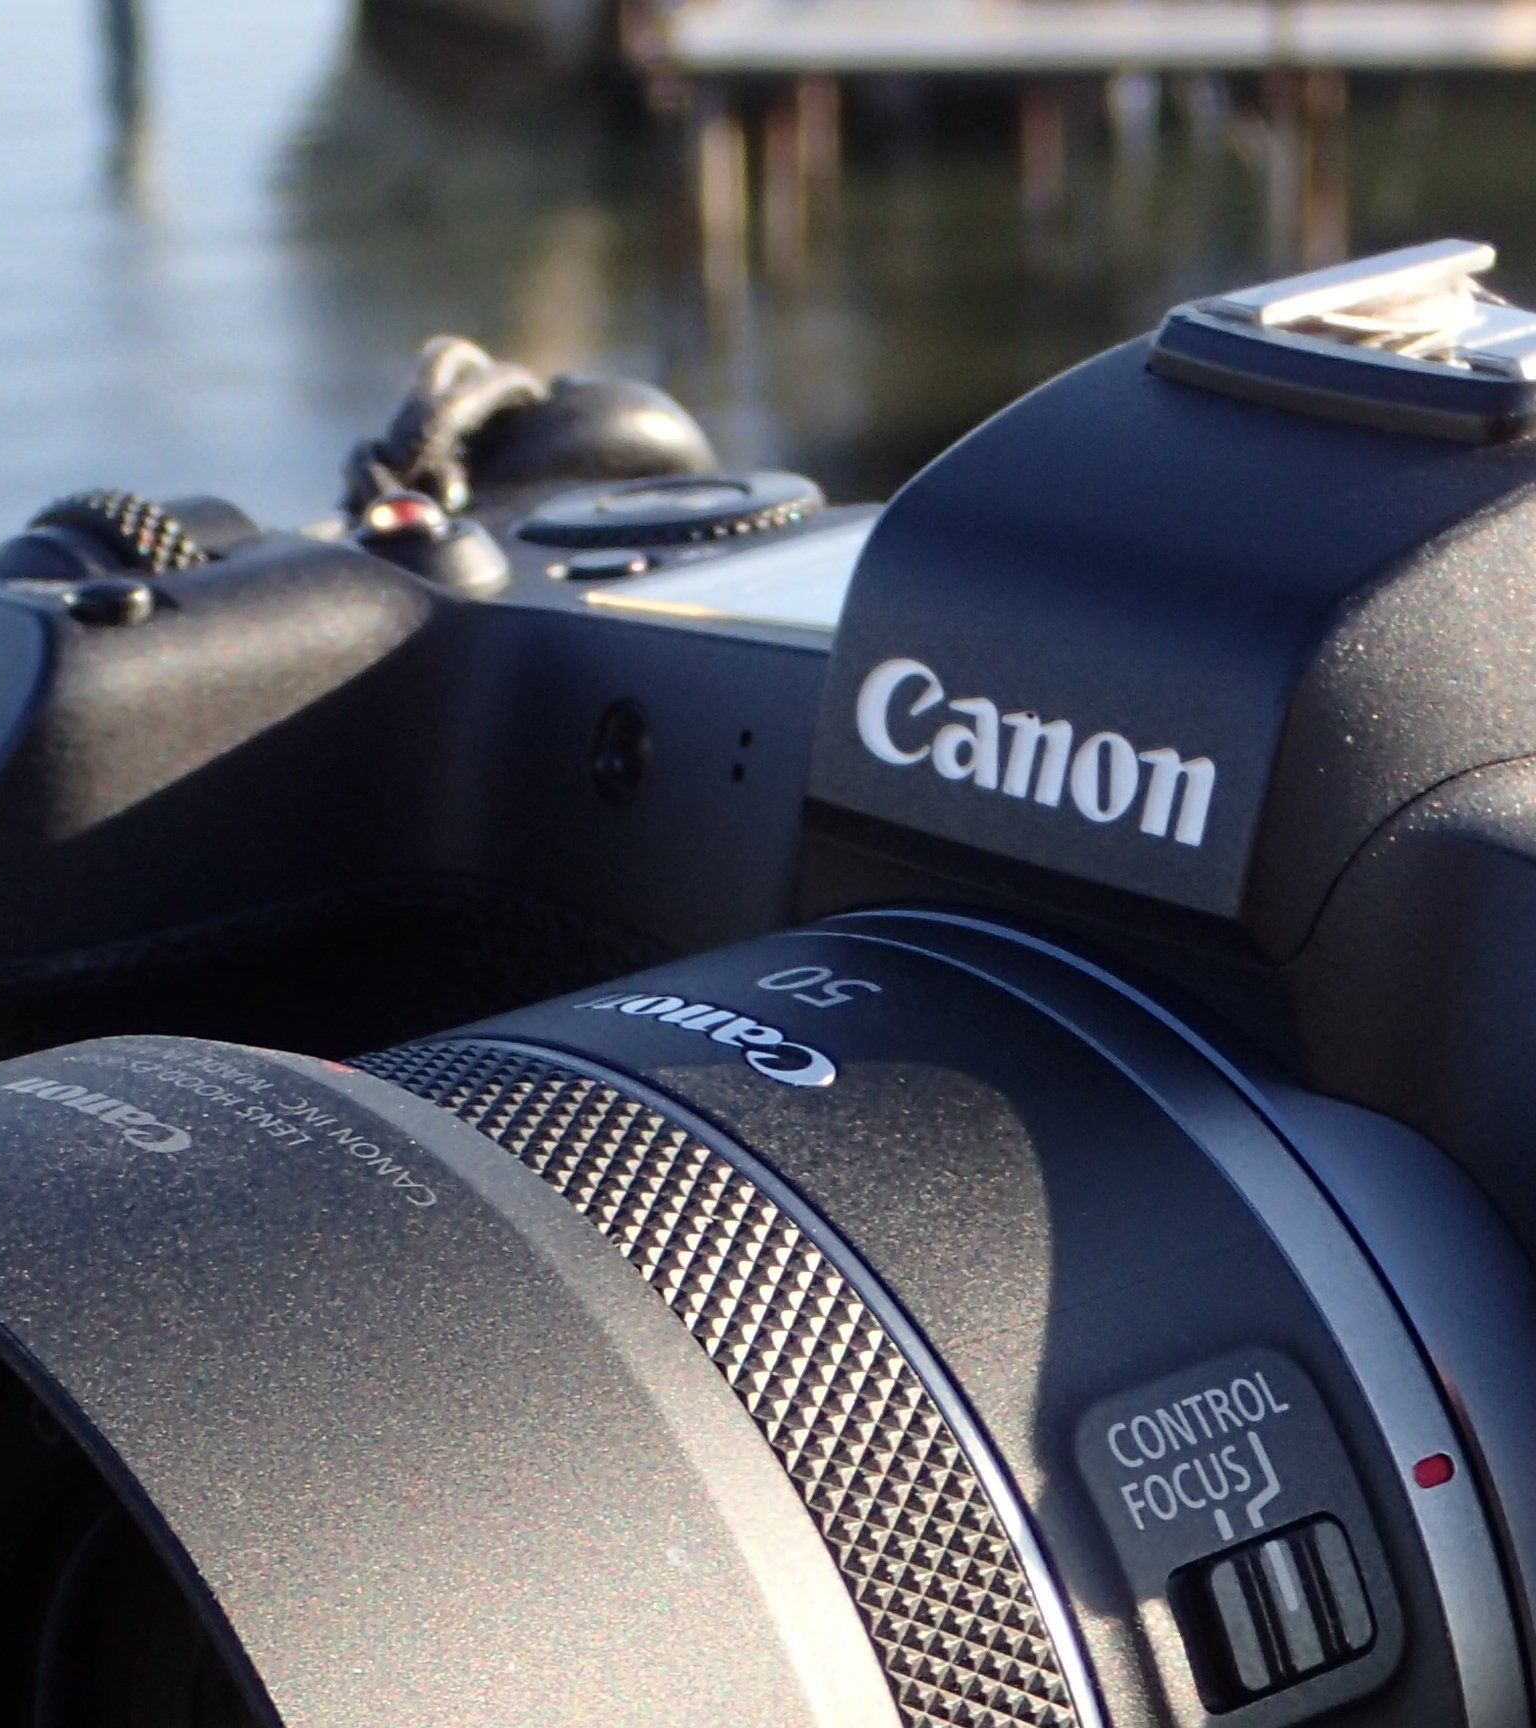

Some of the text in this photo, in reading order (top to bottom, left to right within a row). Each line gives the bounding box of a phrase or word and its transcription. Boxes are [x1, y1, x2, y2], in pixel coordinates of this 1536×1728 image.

[856, 658, 1216, 847] Canon
[757, 966, 883, 1008] 50
[572, 992, 838, 1088] Canon
[1, 1077, 193, 1154] Canon
[157, 1068, 315, 1146] LENS HOOD
[327, 1127, 438, 1208] CANON
[1107, 1371, 1290, 1469] CONTROL
[1120, 1445, 1252, 1531] FOCUS
